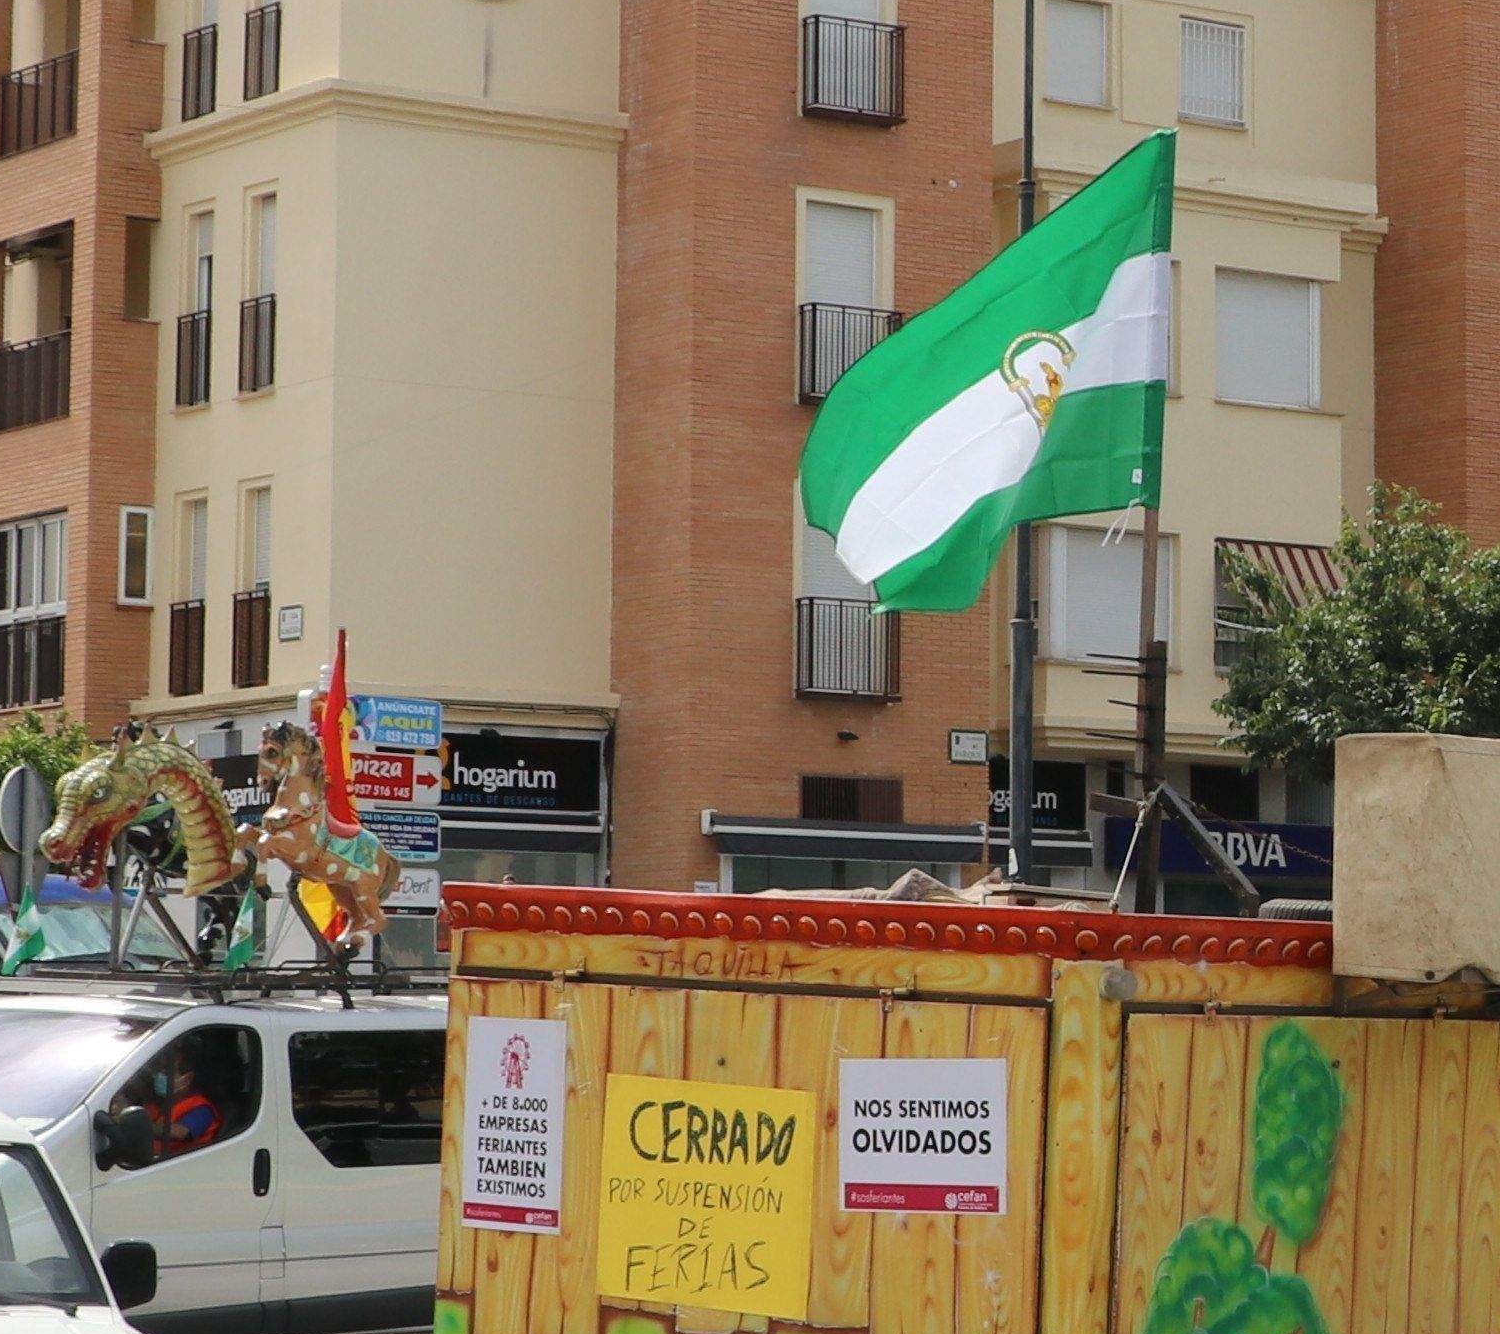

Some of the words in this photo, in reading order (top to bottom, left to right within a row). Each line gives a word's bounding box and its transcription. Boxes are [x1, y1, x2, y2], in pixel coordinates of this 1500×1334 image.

[351, 755, 403, 778] pizza
[453, 751, 556, 793] hogarium
[493, 1096, 507, 1110] DE
[512, 1097, 548, 1113] 8.000
[854, 1099, 892, 1118] NOS
[898, 1099, 990, 1119] SENTIMOS
[479, 1115, 548, 1134] EMPRESAS
[629, 1100, 796, 1166] CERRADO
[478, 1137, 547, 1156] FERIANTES
[852, 1128, 992, 1155] OLVIDADOS
[477, 1157, 546, 1179] TAMBIEN
[476, 1179, 546, 1199] EXISTIMOS
[609, 1176, 645, 1204] POR
[654, 1176, 783, 1214] SUSPENSIÓN
[957, 1191, 988, 1202] cefan
[678, 1216, 714, 1239] DE
[625, 1241, 771, 1294] FERIAS
